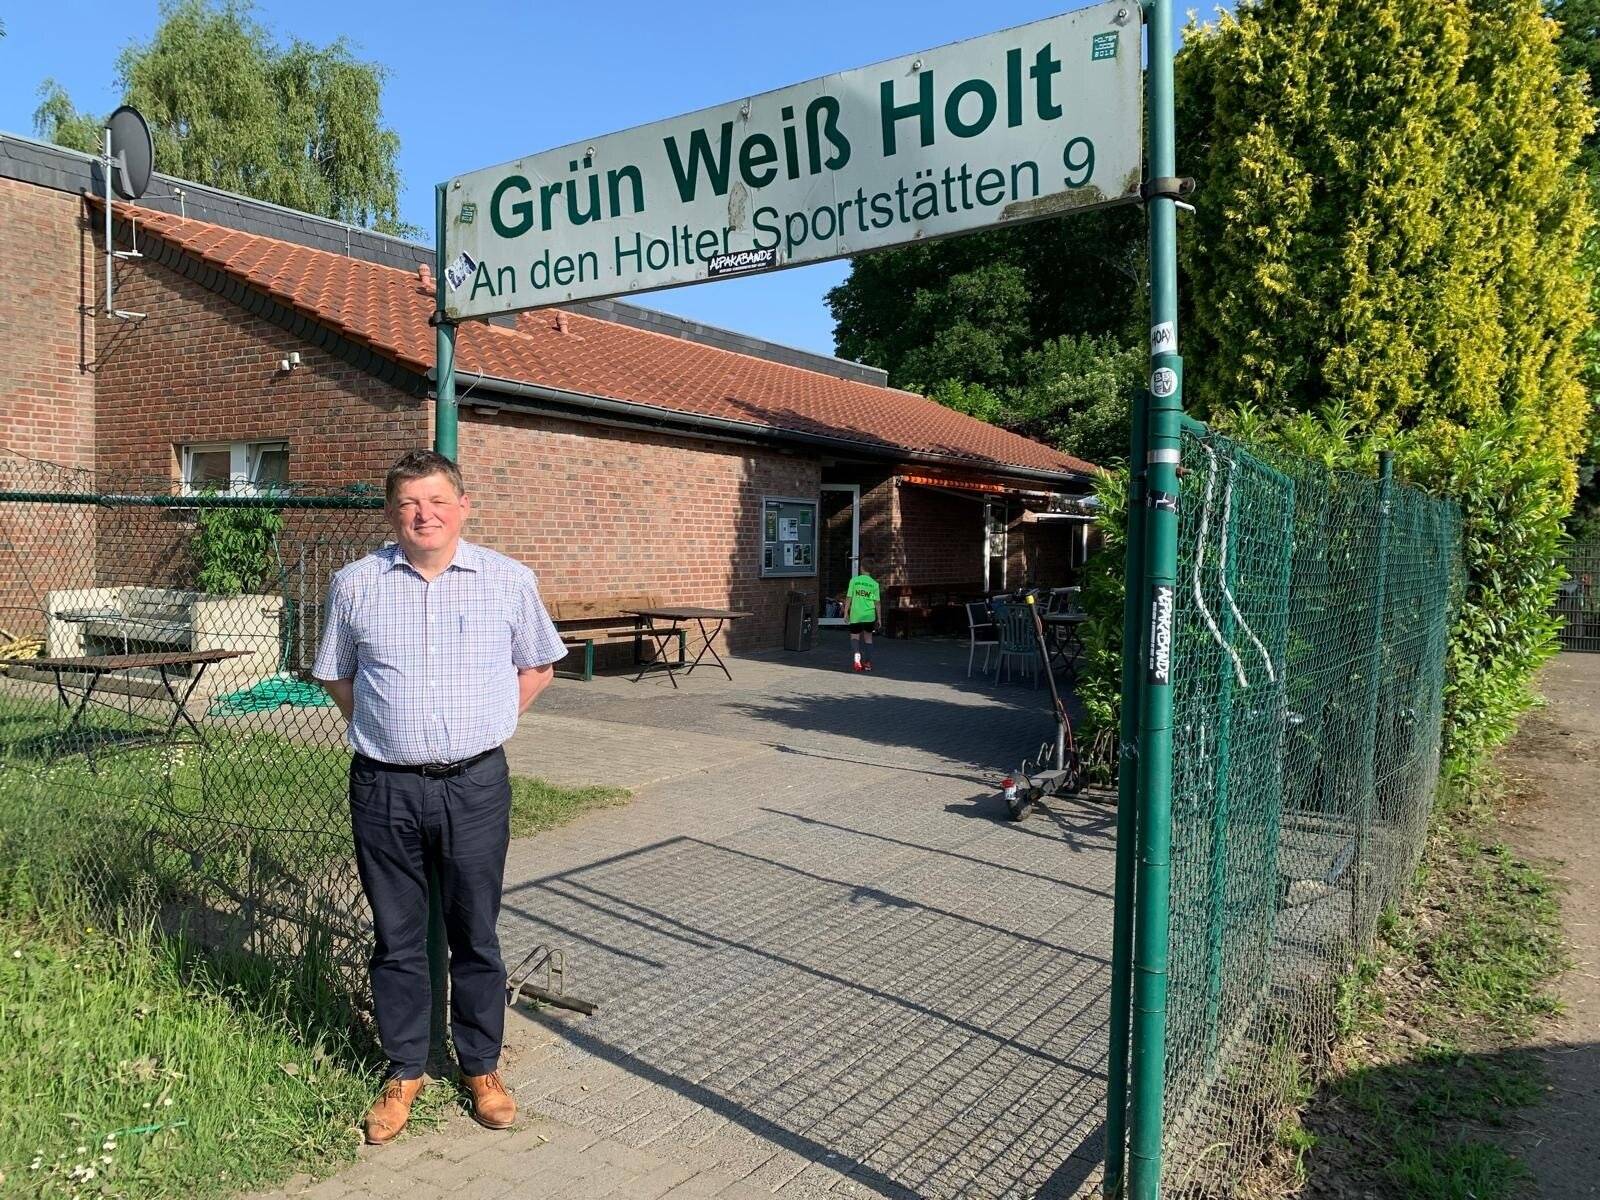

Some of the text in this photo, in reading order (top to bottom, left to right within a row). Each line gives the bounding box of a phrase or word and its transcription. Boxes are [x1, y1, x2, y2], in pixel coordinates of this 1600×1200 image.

[470, 261, 516, 300] An
[530, 249, 598, 289] den
[615, 224, 736, 276] Holter
[753, 160, 1039, 258] Sportstätten
[1063, 136, 1095, 189] 9
[490, 42, 1063, 239] Grün Weiß Holt
